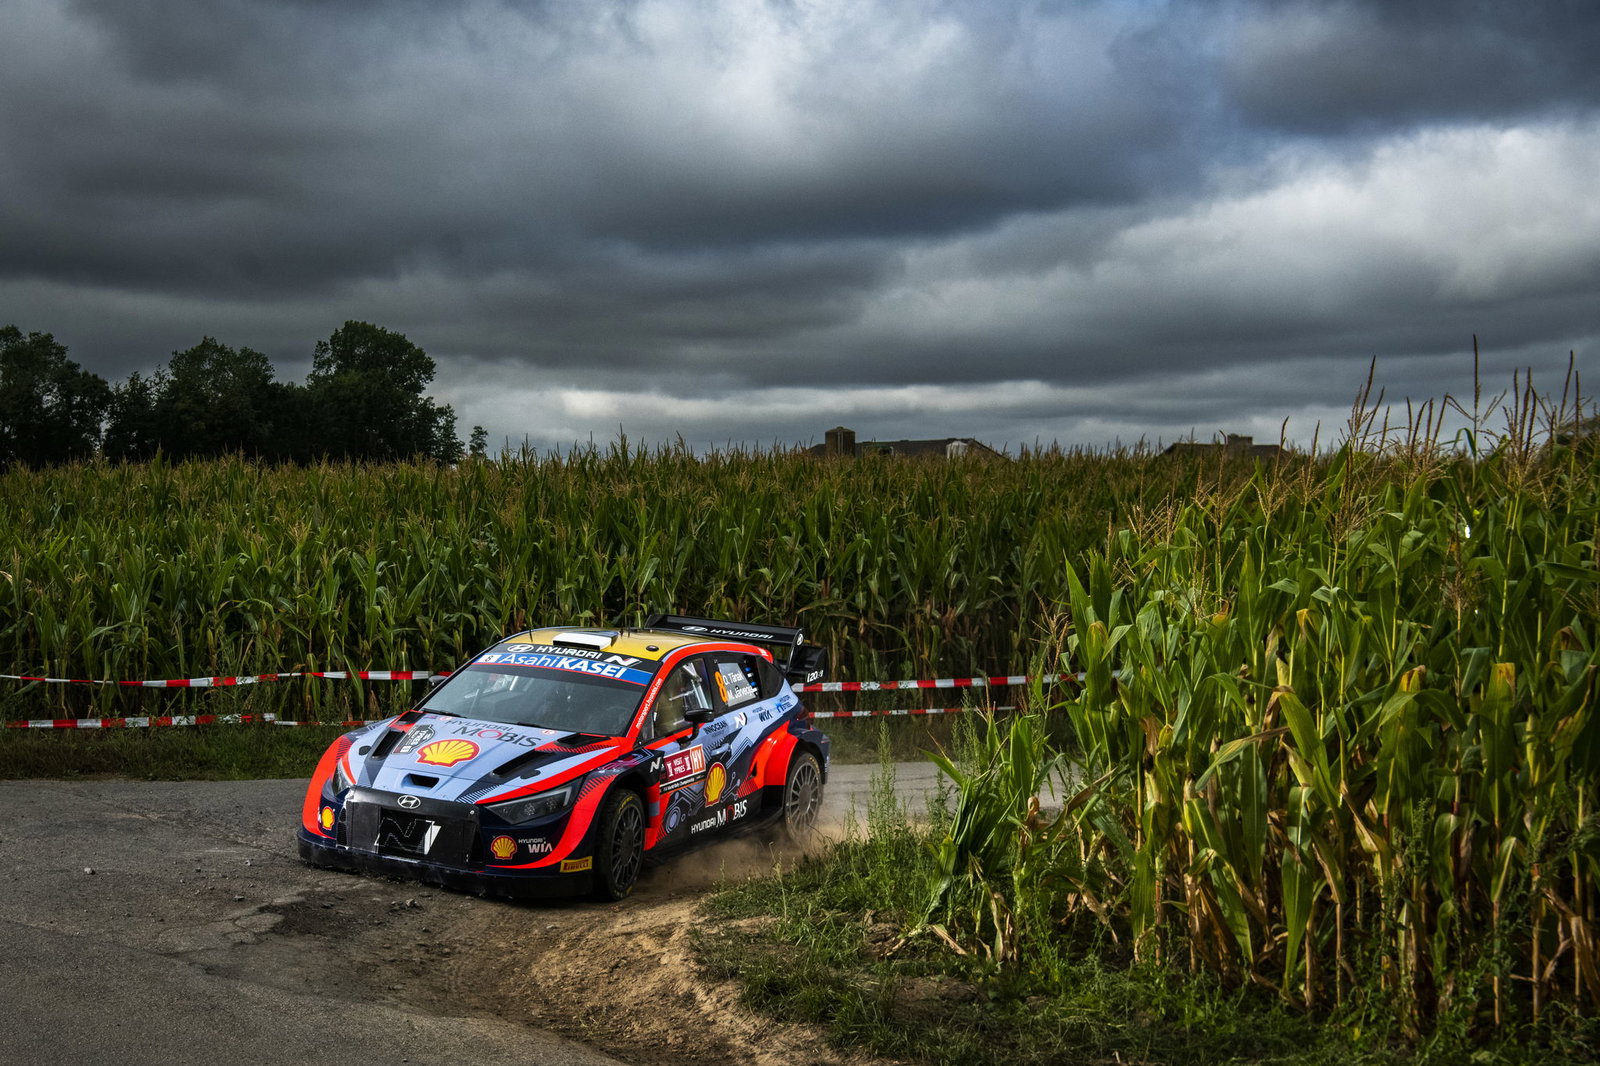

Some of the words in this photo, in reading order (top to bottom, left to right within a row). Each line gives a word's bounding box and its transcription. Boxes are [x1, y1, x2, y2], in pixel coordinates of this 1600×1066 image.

[710, 629, 774, 640] HYUNDAI
[536, 646, 602, 660] HYUNDAI
[501, 653, 627, 678] AsahiKASEI
[714, 671, 728, 703] 8
[446, 720, 514, 732] HYUNDAI
[452, 726, 541, 748] MOBIS
[692, 748, 703, 771] HY
[691, 817, 717, 834] HYUNDAI
[716, 799, 748, 828] MOBIS
[528, 842, 553, 854] WIA
